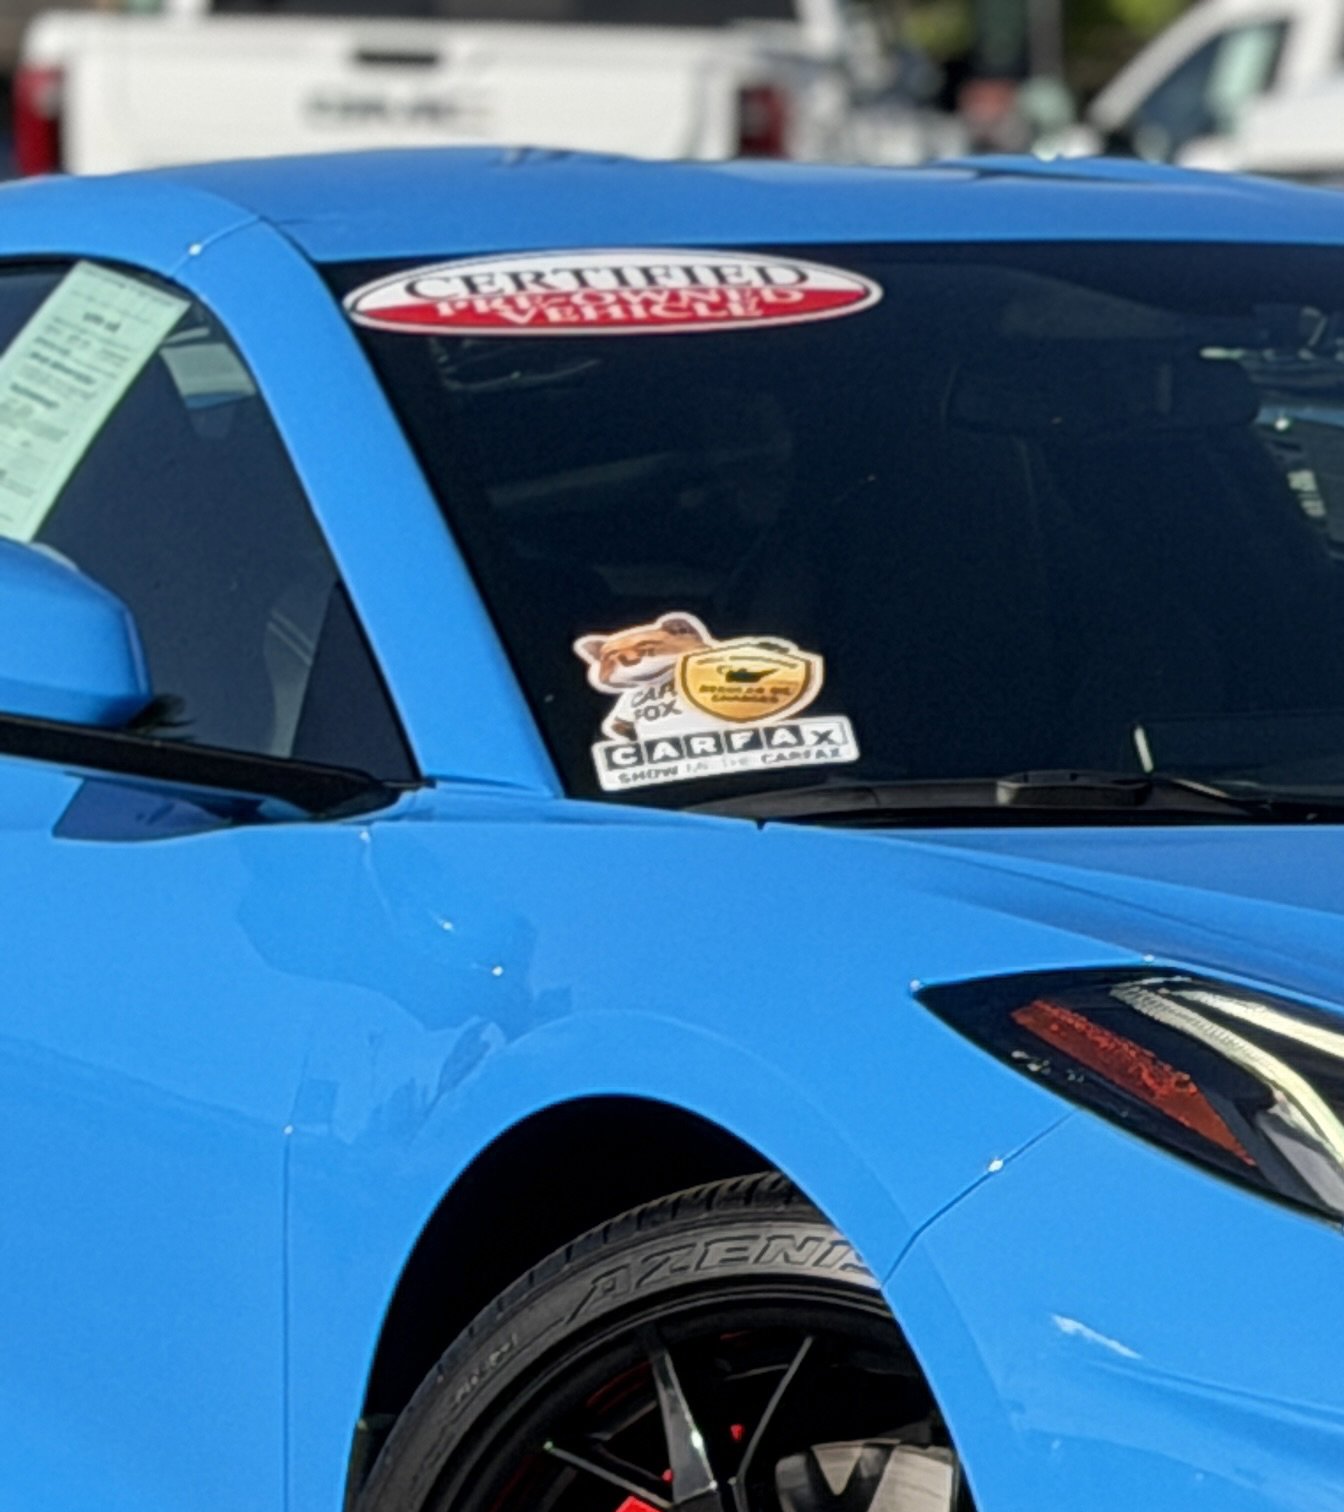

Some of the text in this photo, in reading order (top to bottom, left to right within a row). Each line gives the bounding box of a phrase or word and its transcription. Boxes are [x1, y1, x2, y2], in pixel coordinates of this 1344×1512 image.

[404, 264, 808, 299] CERTIFIED
[435, 286, 806, 317] PRE-OWNED
[498, 297, 764, 325] VEHICLE
[633, 700, 683, 722] FOX
[607, 726, 842, 768] CARFAX
[617, 767, 679, 785] SHOW
